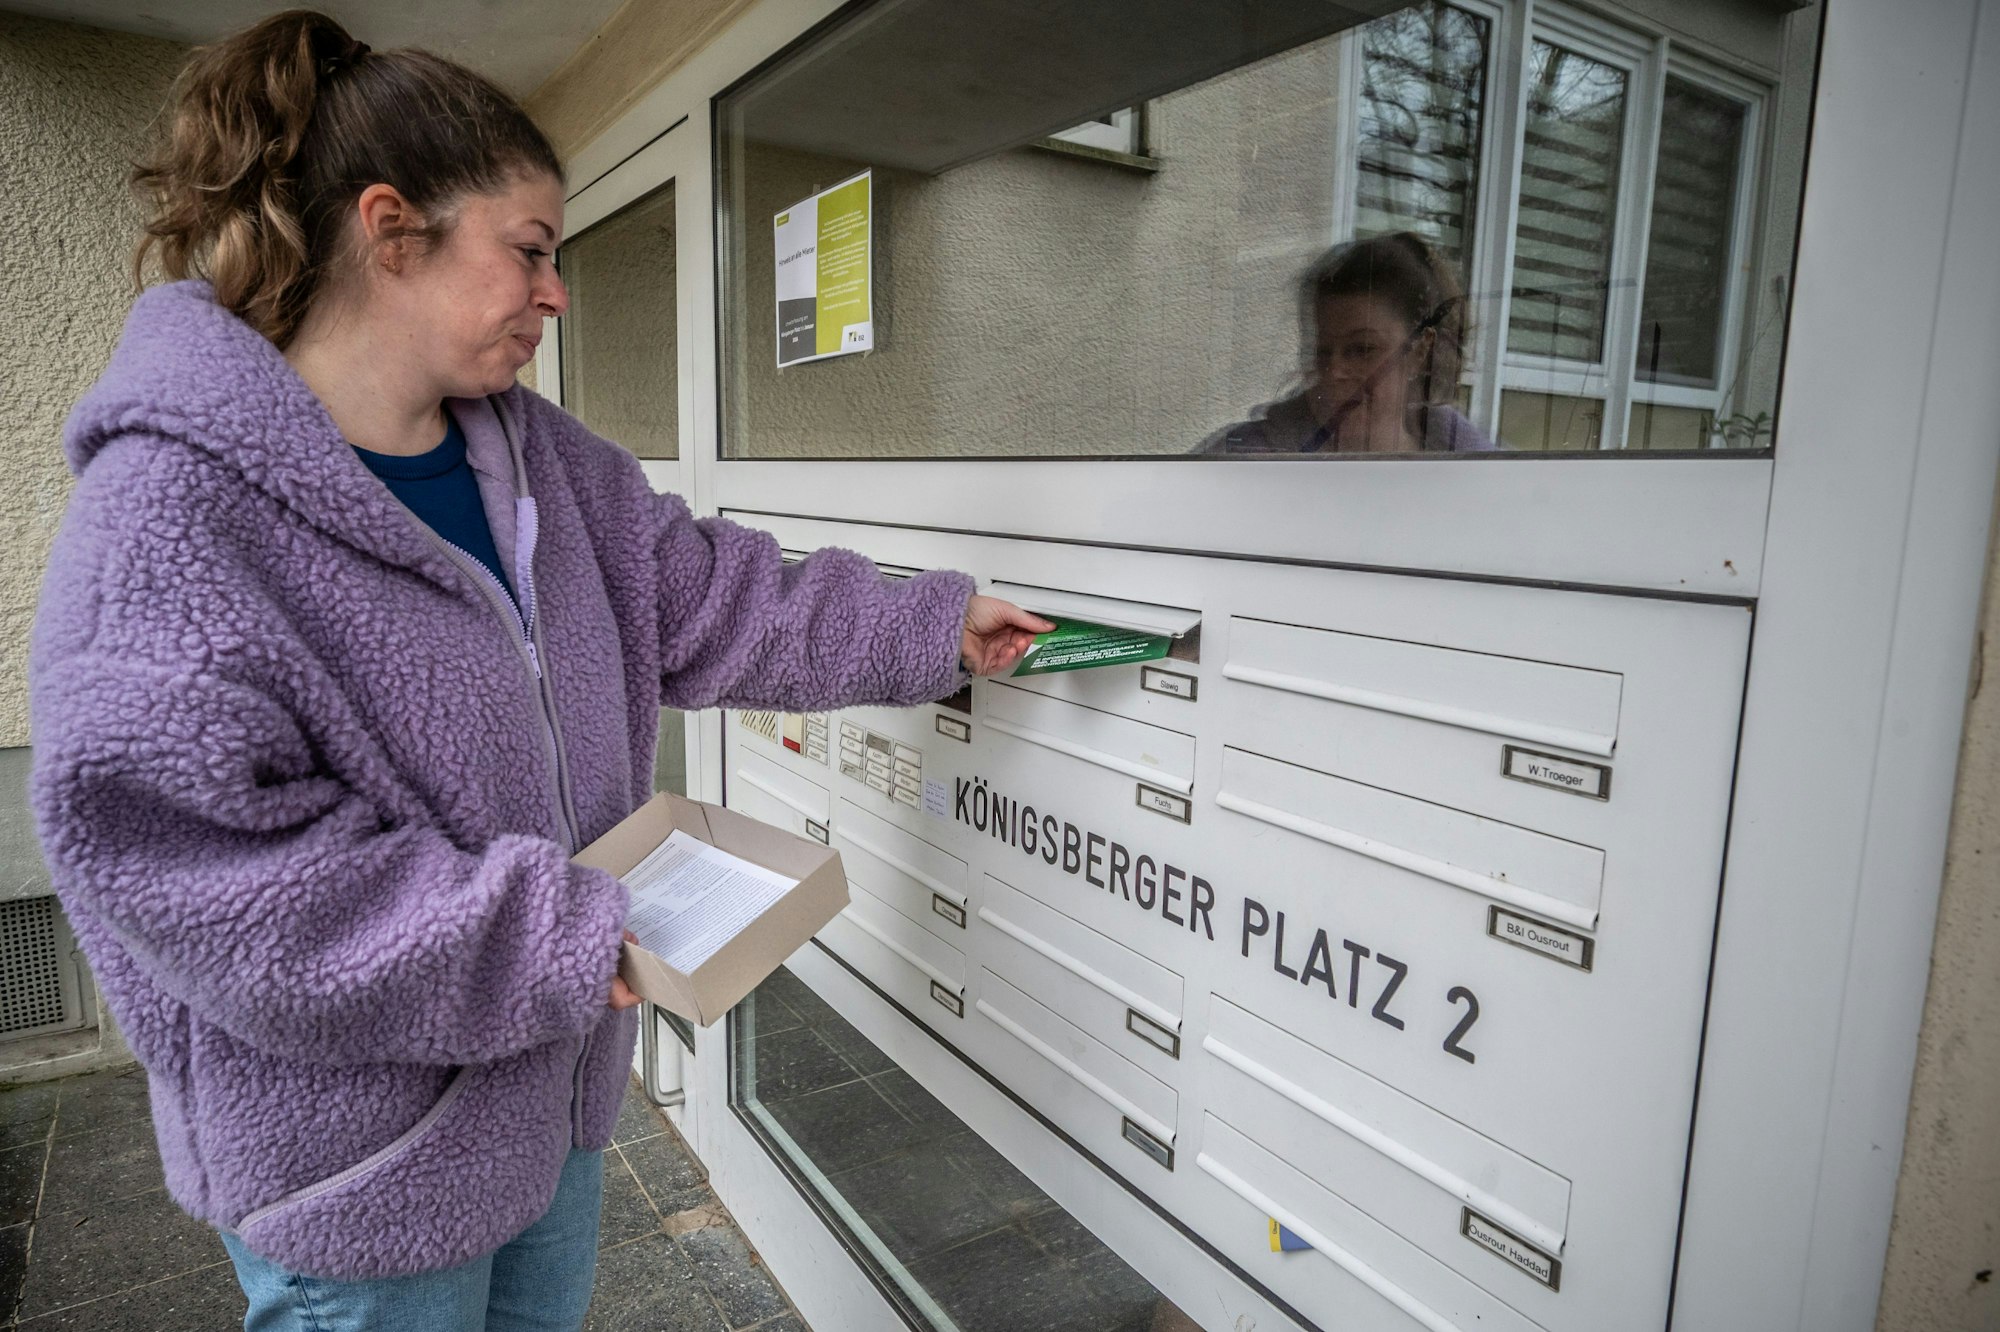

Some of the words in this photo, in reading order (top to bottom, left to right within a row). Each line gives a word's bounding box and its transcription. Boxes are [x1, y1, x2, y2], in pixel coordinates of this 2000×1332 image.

[1160, 679, 1179, 693] Slawig
[1528, 763, 1584, 786] W.Troeger
[1154, 796, 1172, 810] Fuchs
[955, 776, 1215, 941] KÖNIGSBERGER
[1241, 897, 1409, 1031] PLATZ
[1443, 985, 1480, 1065] 2
[1527, 929, 1570, 952] Ousrout
[1468, 1224, 1506, 1253] Ousrout
[1509, 1247, 1549, 1279] Haddad
